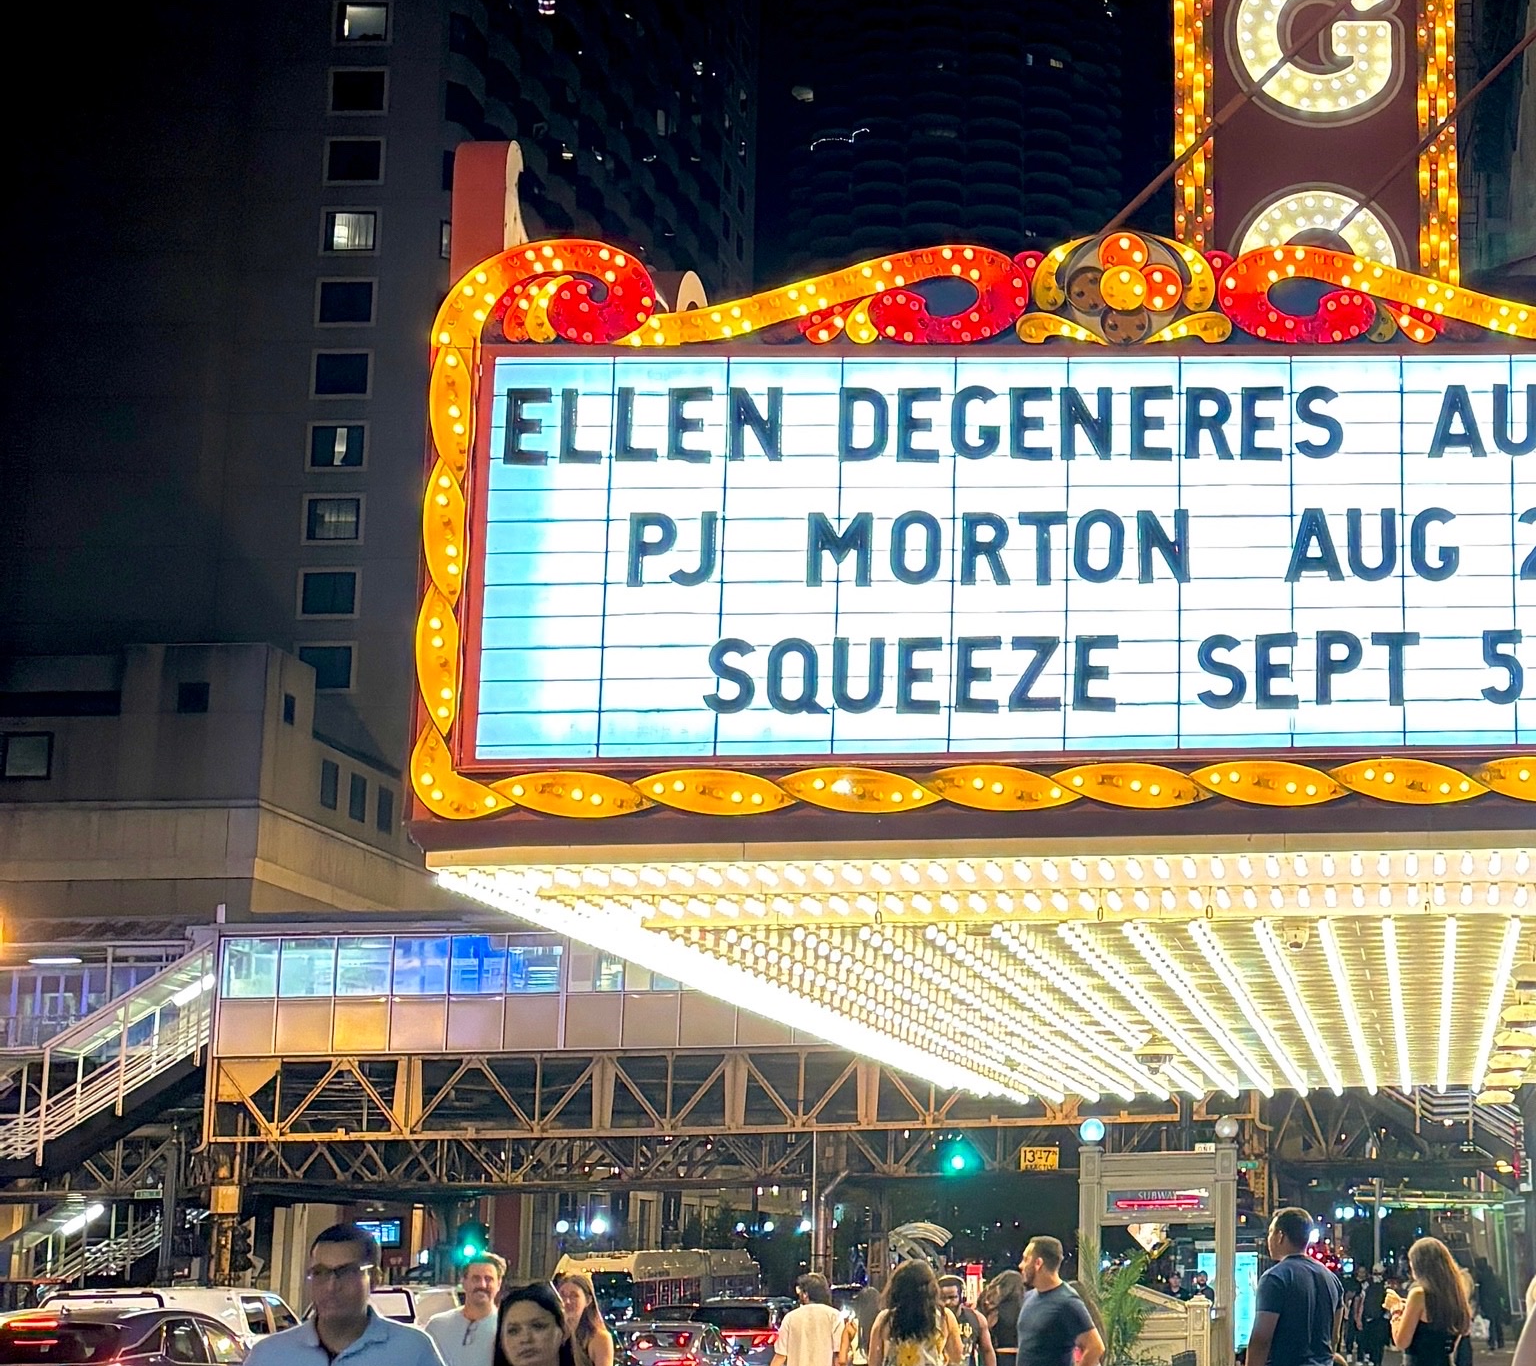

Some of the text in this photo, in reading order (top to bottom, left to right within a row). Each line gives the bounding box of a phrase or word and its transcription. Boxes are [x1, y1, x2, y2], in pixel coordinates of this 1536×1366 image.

[502, 386, 784, 466] ELLEN
[838, 384, 1344, 463] DEGENERES
[626, 510, 719, 588] PJ
[806, 507, 1191, 588] MORTON
[1284, 506, 1460, 583] AUG
[702, 629, 1524, 716] SQUEEZE SEPT 5
